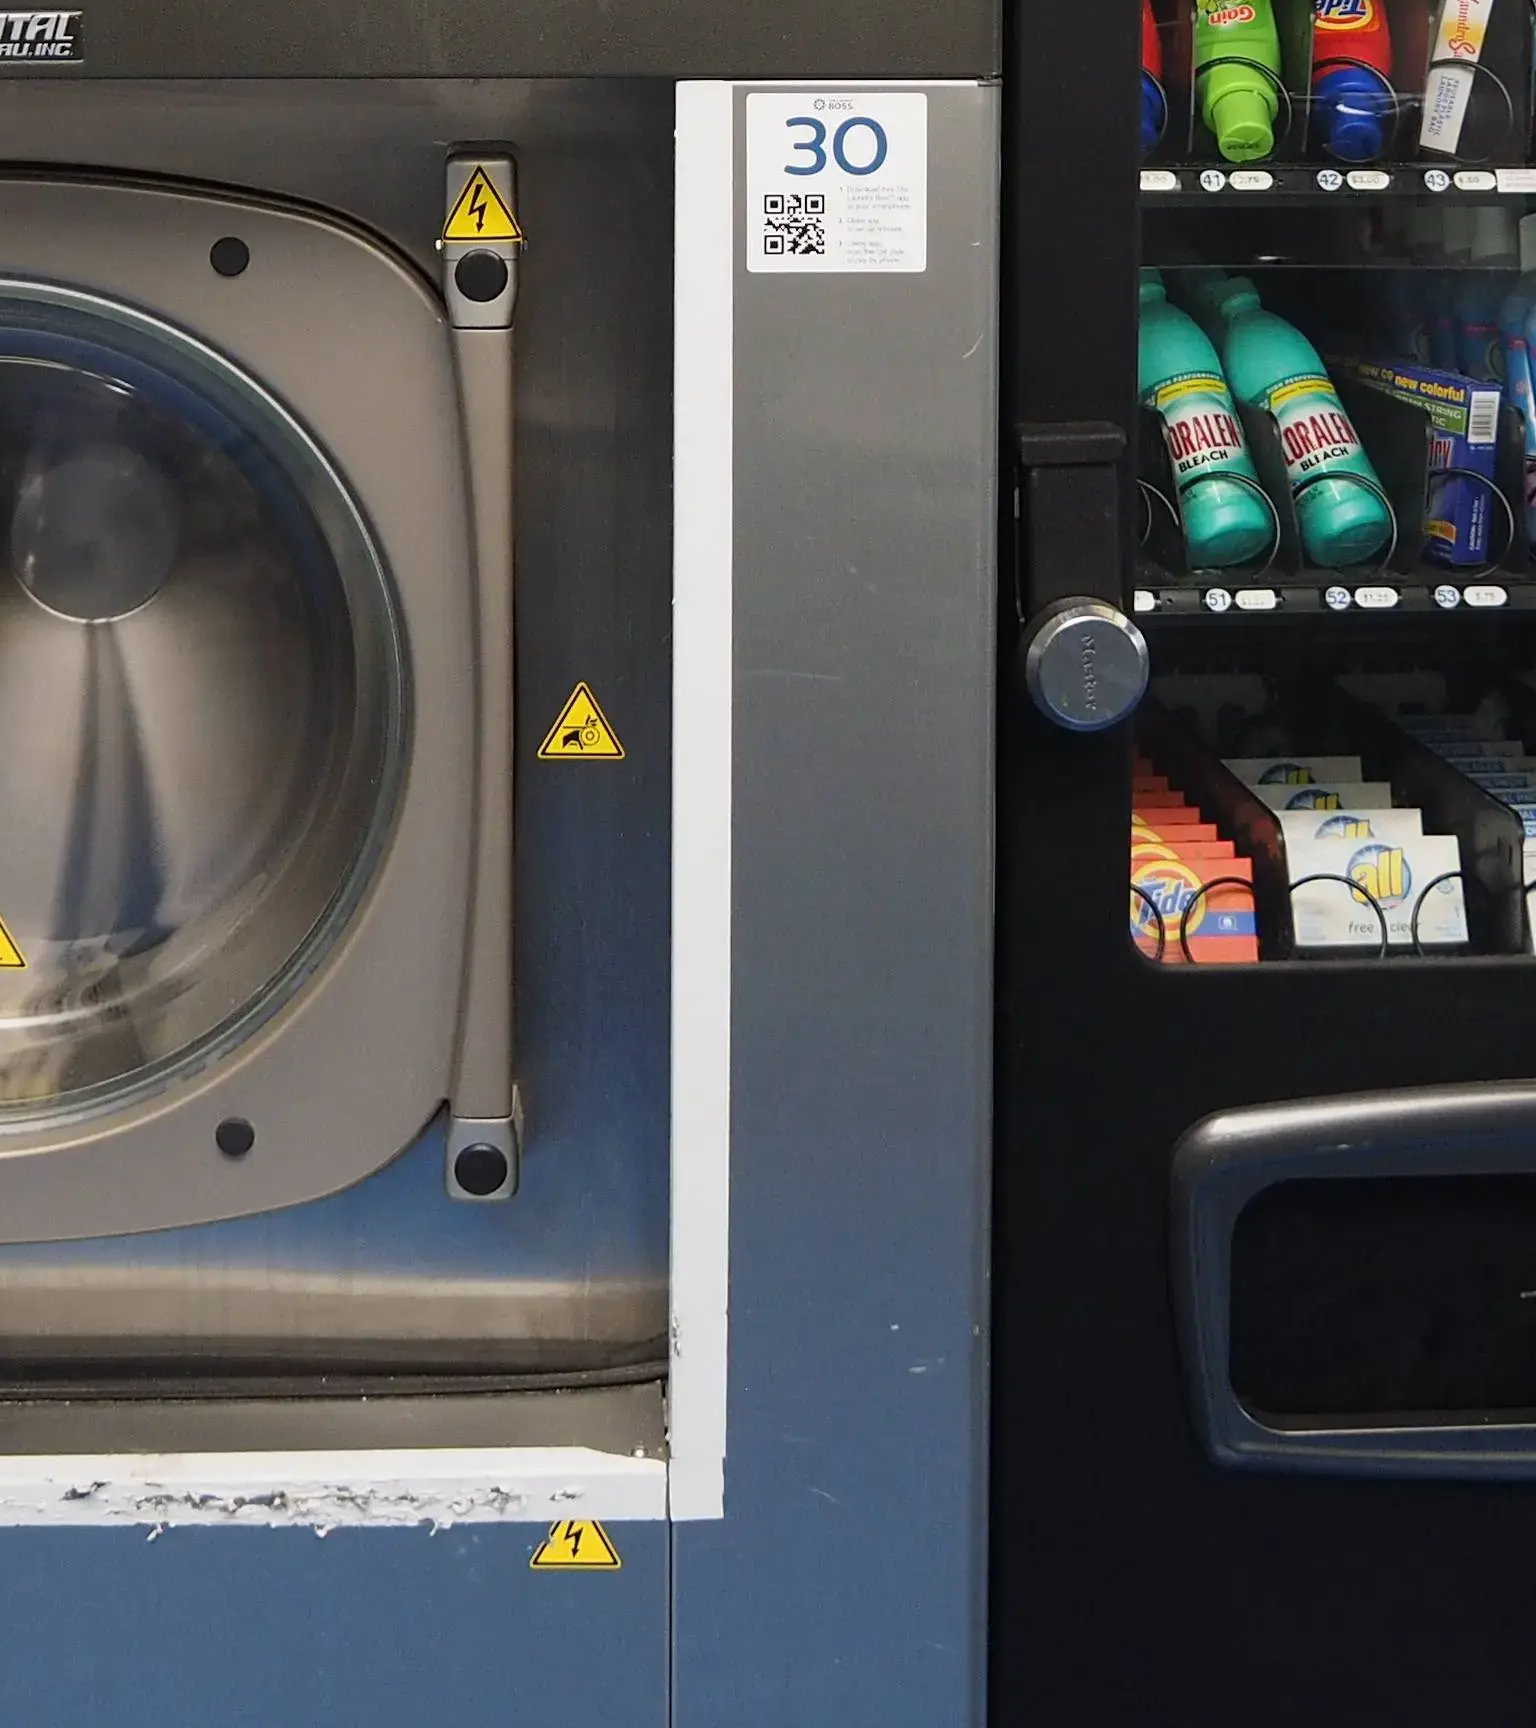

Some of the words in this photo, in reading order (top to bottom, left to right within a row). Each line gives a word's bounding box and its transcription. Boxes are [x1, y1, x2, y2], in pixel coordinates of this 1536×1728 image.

[1210, 5, 1255, 25] Gain
[784, 116, 887, 176] 30
[1203, 174, 1221, 186] 41
[1427, 173, 1445, 186] 43
[1394, 375, 1418, 390] new
[1419, 381, 1465, 402] colorful
[1179, 449, 1229, 473] BLEACH
[1327, 591, 1347, 605] 52
